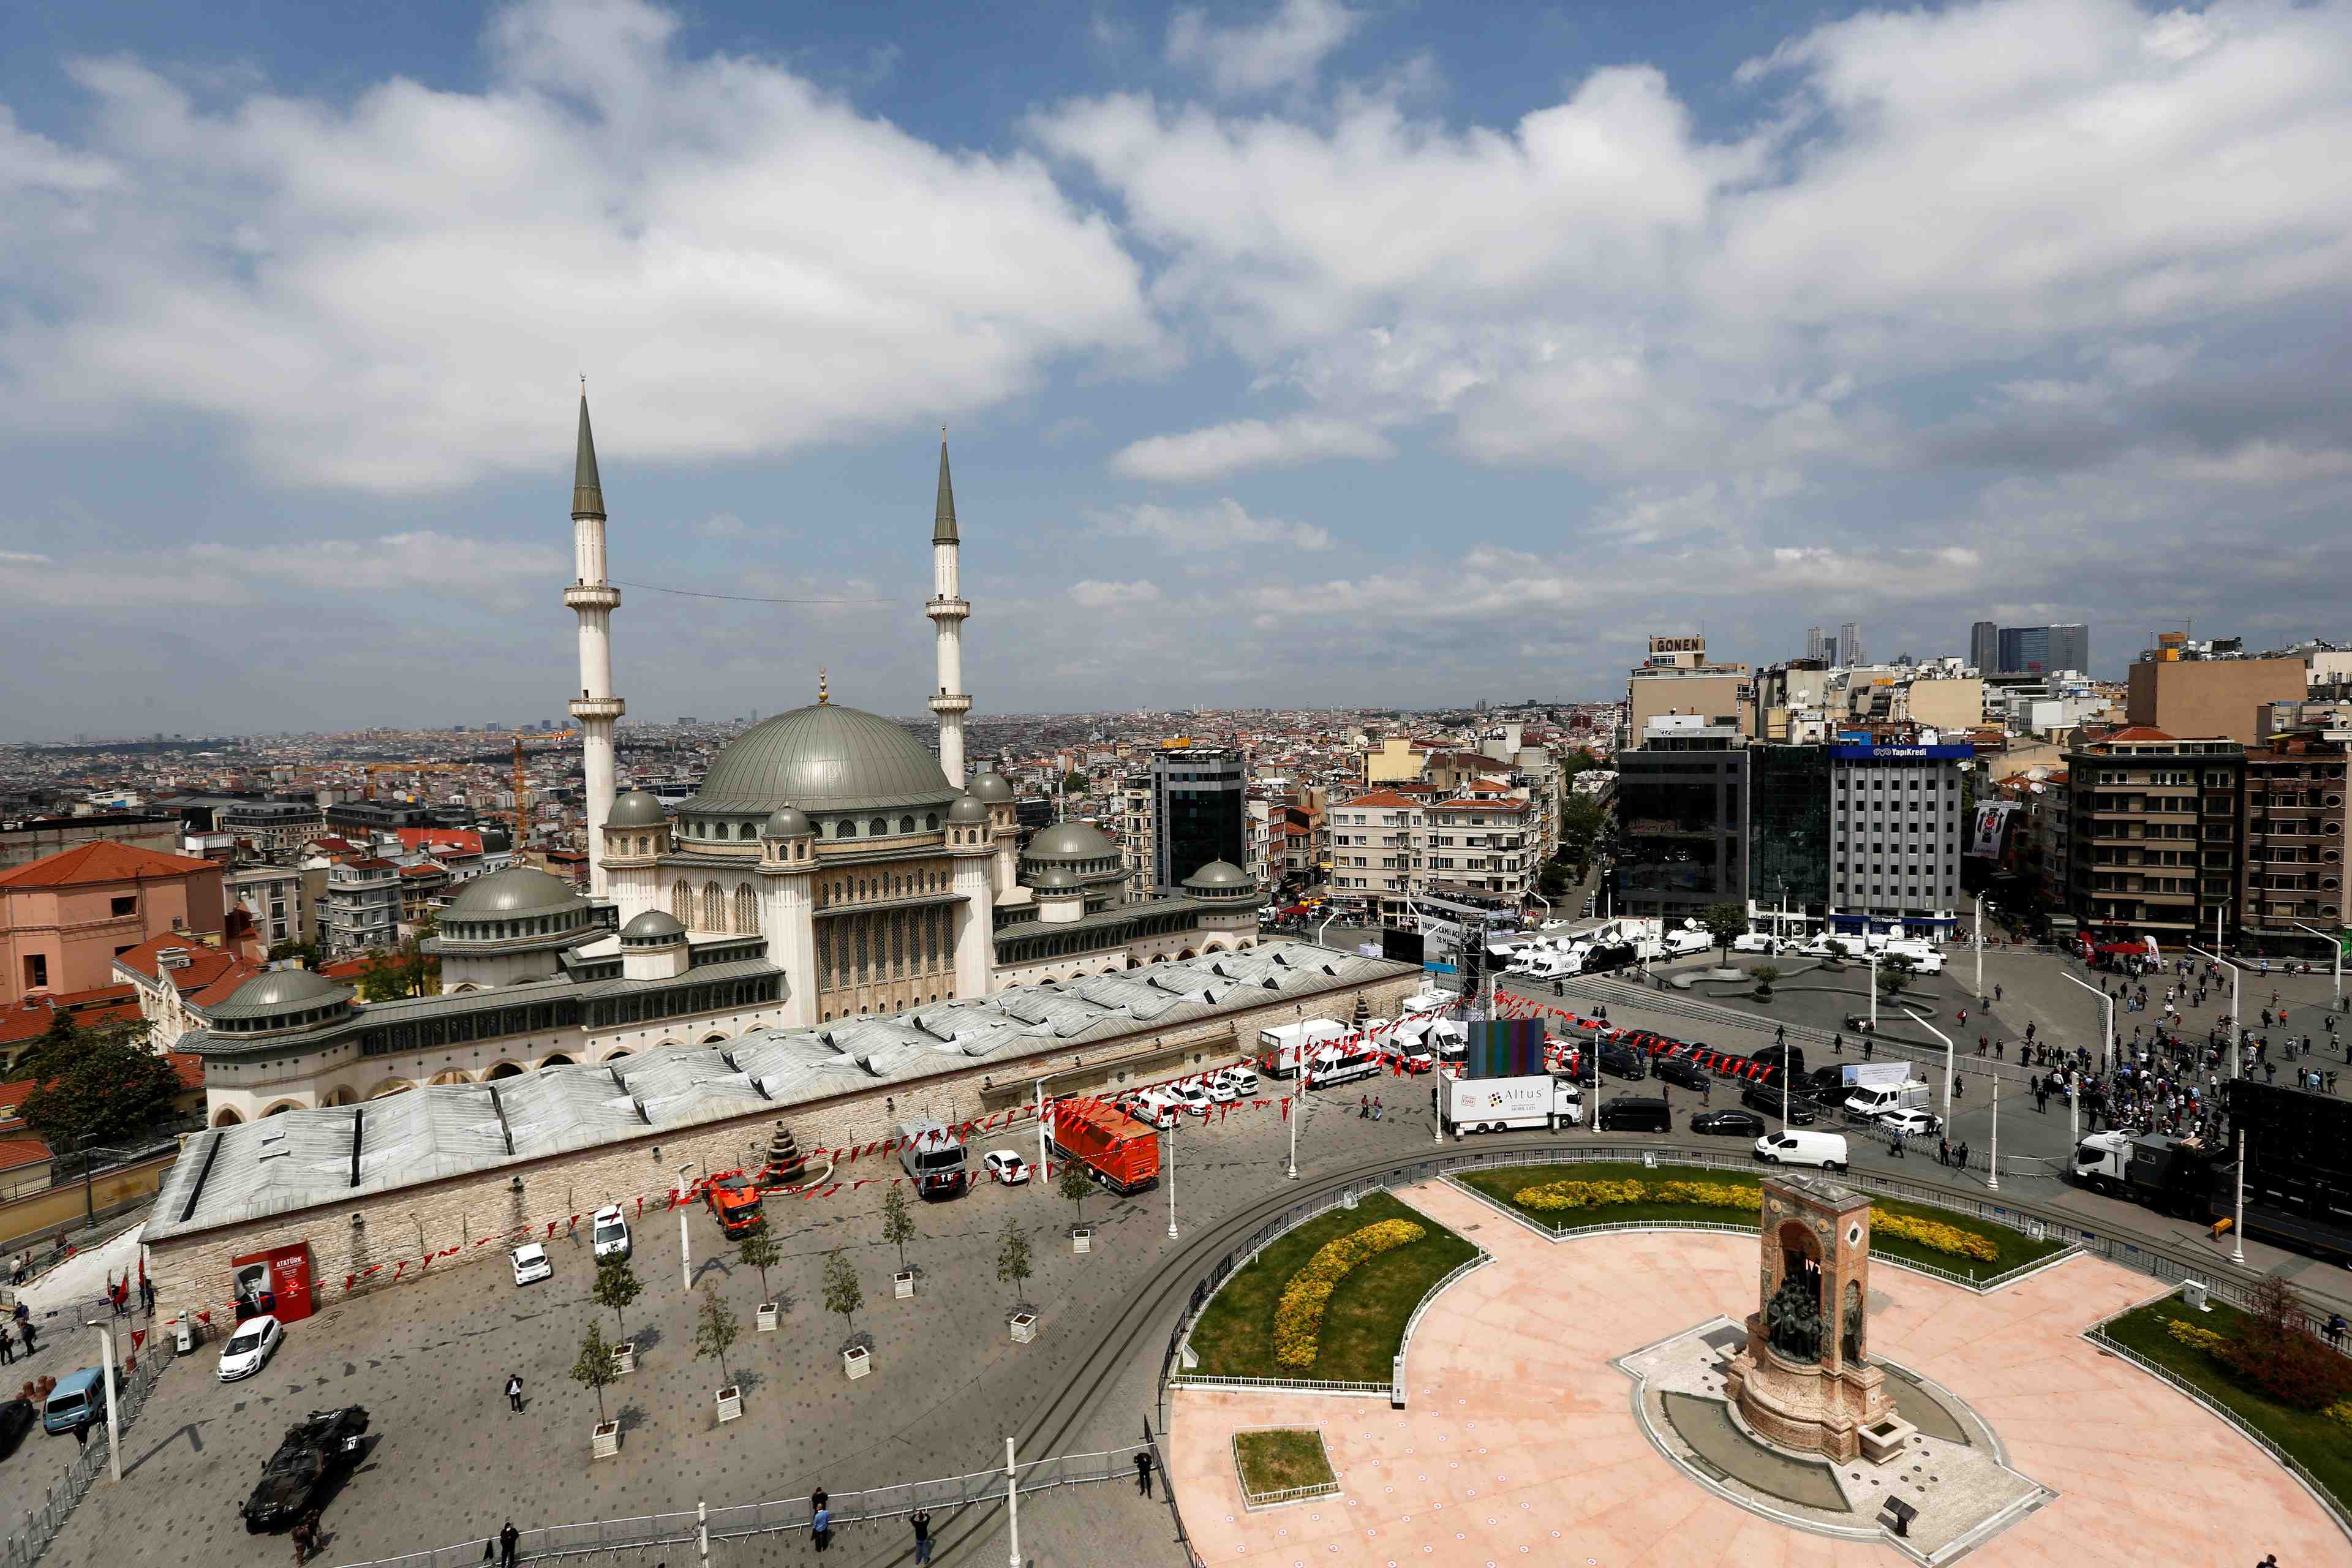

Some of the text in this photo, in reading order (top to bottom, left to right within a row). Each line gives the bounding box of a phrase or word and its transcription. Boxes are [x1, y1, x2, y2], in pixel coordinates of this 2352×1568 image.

[1891, 748, 1926, 756] YapıKredi
[1505, 1088, 1542, 1099] Altus
[276, 1256, 303, 1268] ATATÜRK
[347, 1439, 356, 1450] 67
